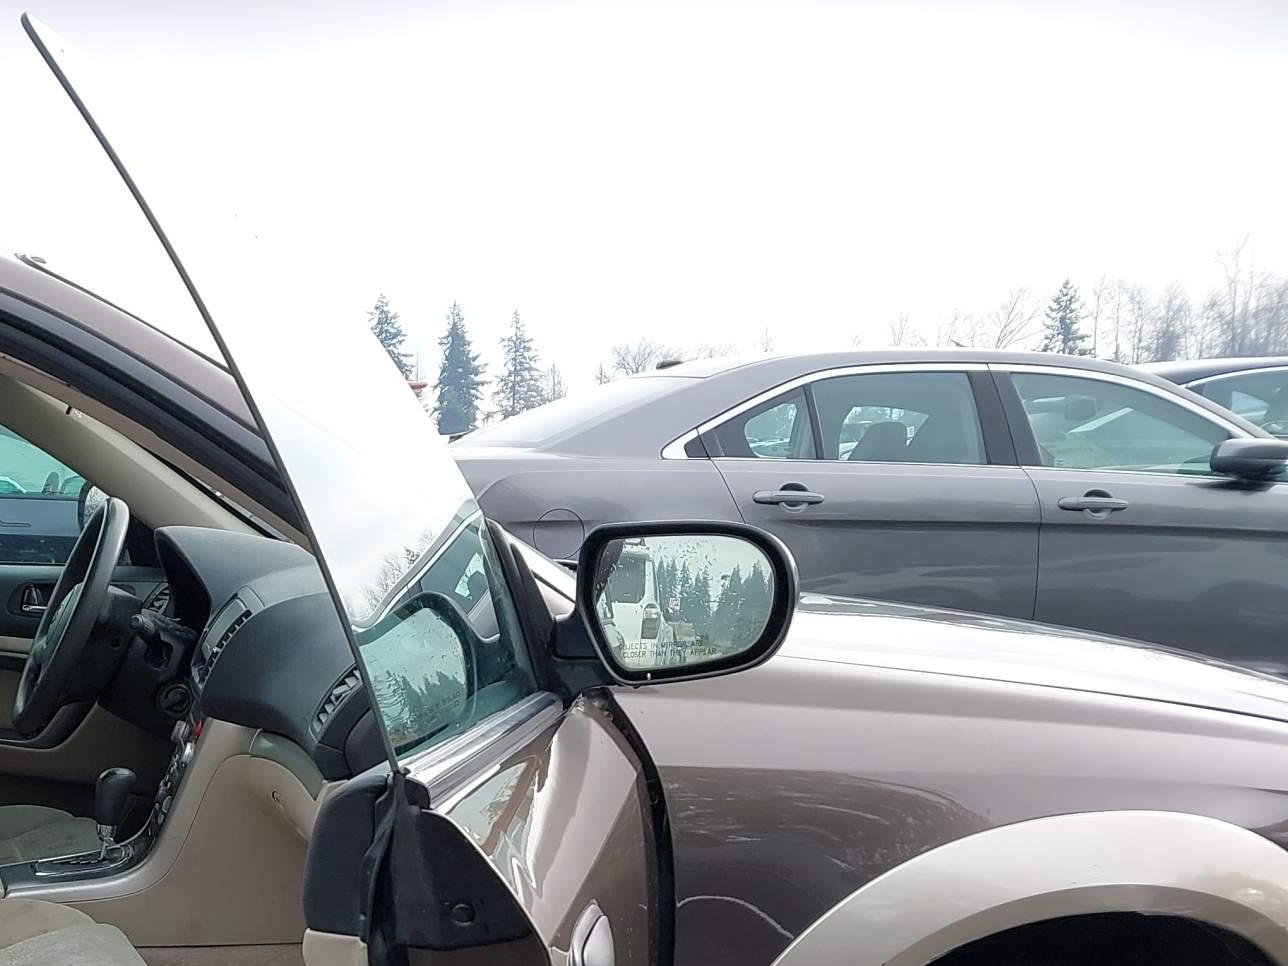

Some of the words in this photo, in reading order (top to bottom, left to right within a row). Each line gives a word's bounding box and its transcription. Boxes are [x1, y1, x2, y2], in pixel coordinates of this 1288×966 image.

[623, 651, 647, 659] CLOSER
[650, 650, 667, 658] THAN
[690, 648, 718, 657] APPEAR
